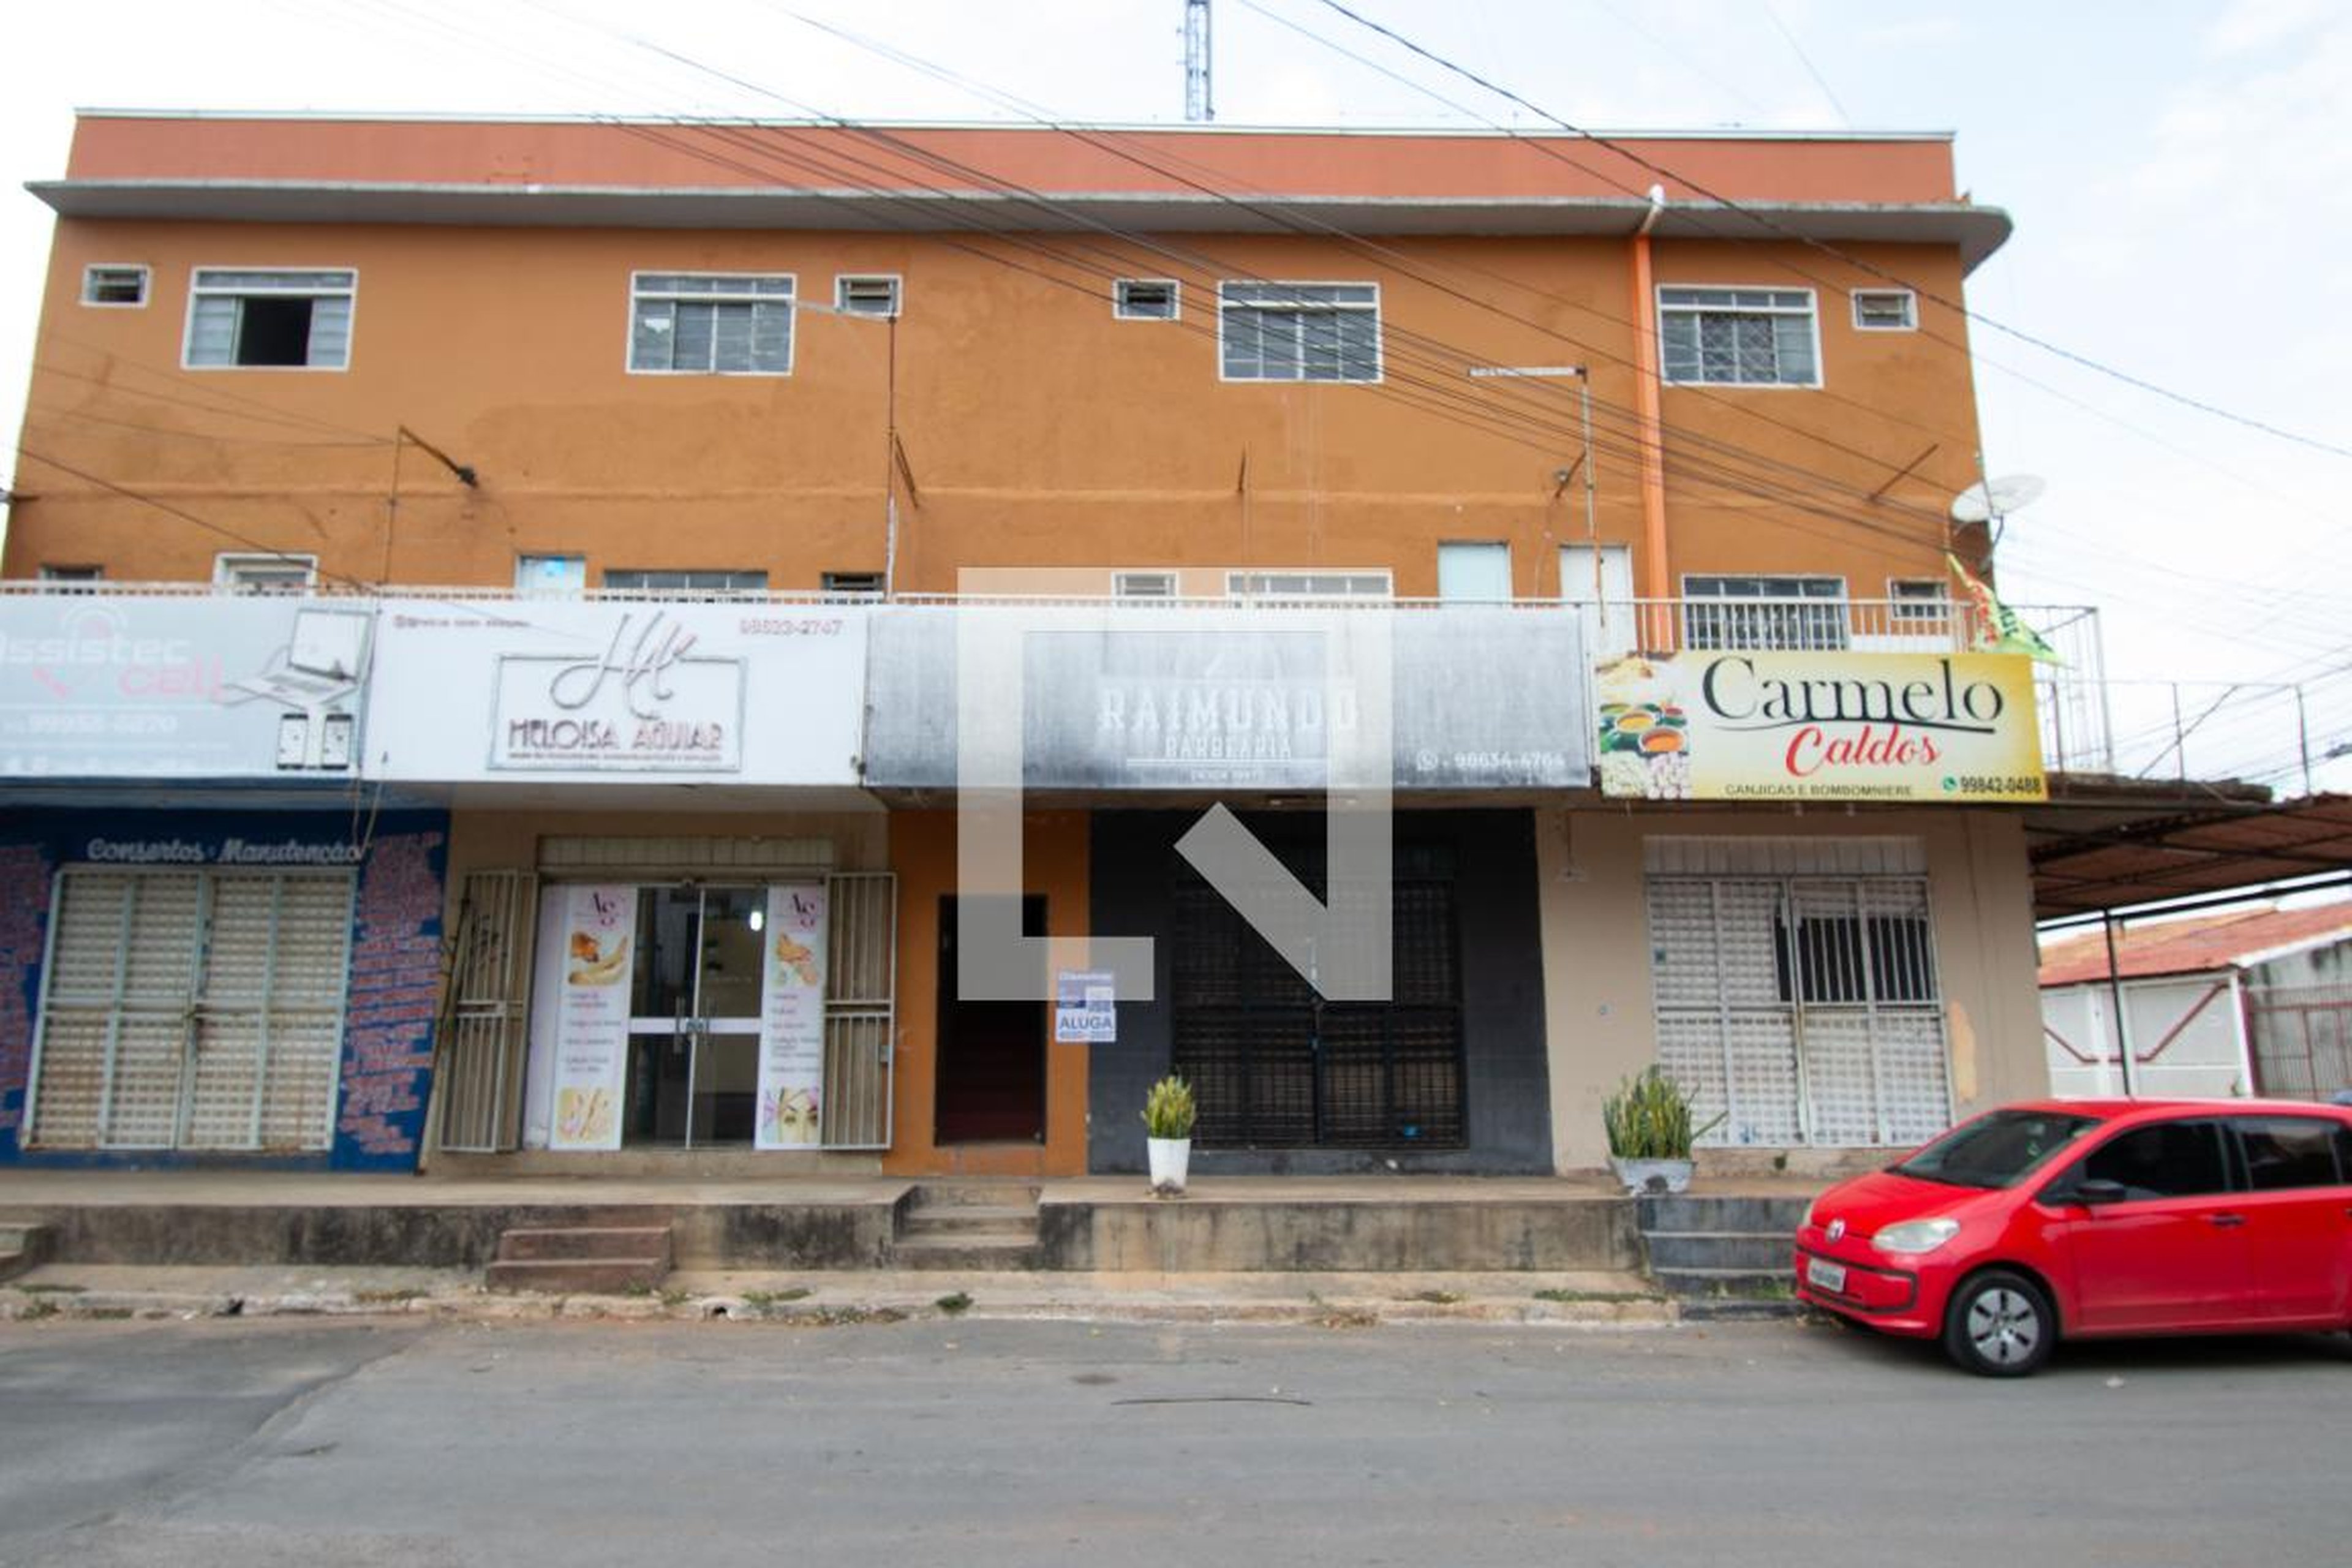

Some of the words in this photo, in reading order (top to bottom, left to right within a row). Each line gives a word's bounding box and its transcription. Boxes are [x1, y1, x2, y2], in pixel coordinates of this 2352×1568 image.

[1703, 657, 2003, 722] Carmelo
[1096, 686, 1358, 732] RAIMUNDO
[1165, 734, 1292, 759] BARBEARIA
[1785, 725, 1941, 777] Caldos
[1725, 784, 1795, 796] CANJICAS
[1797, 785, 1805, 796] E
[87, 838, 205, 862] Consertos
[1059, 1015, 1113, 1030] ALUGA
